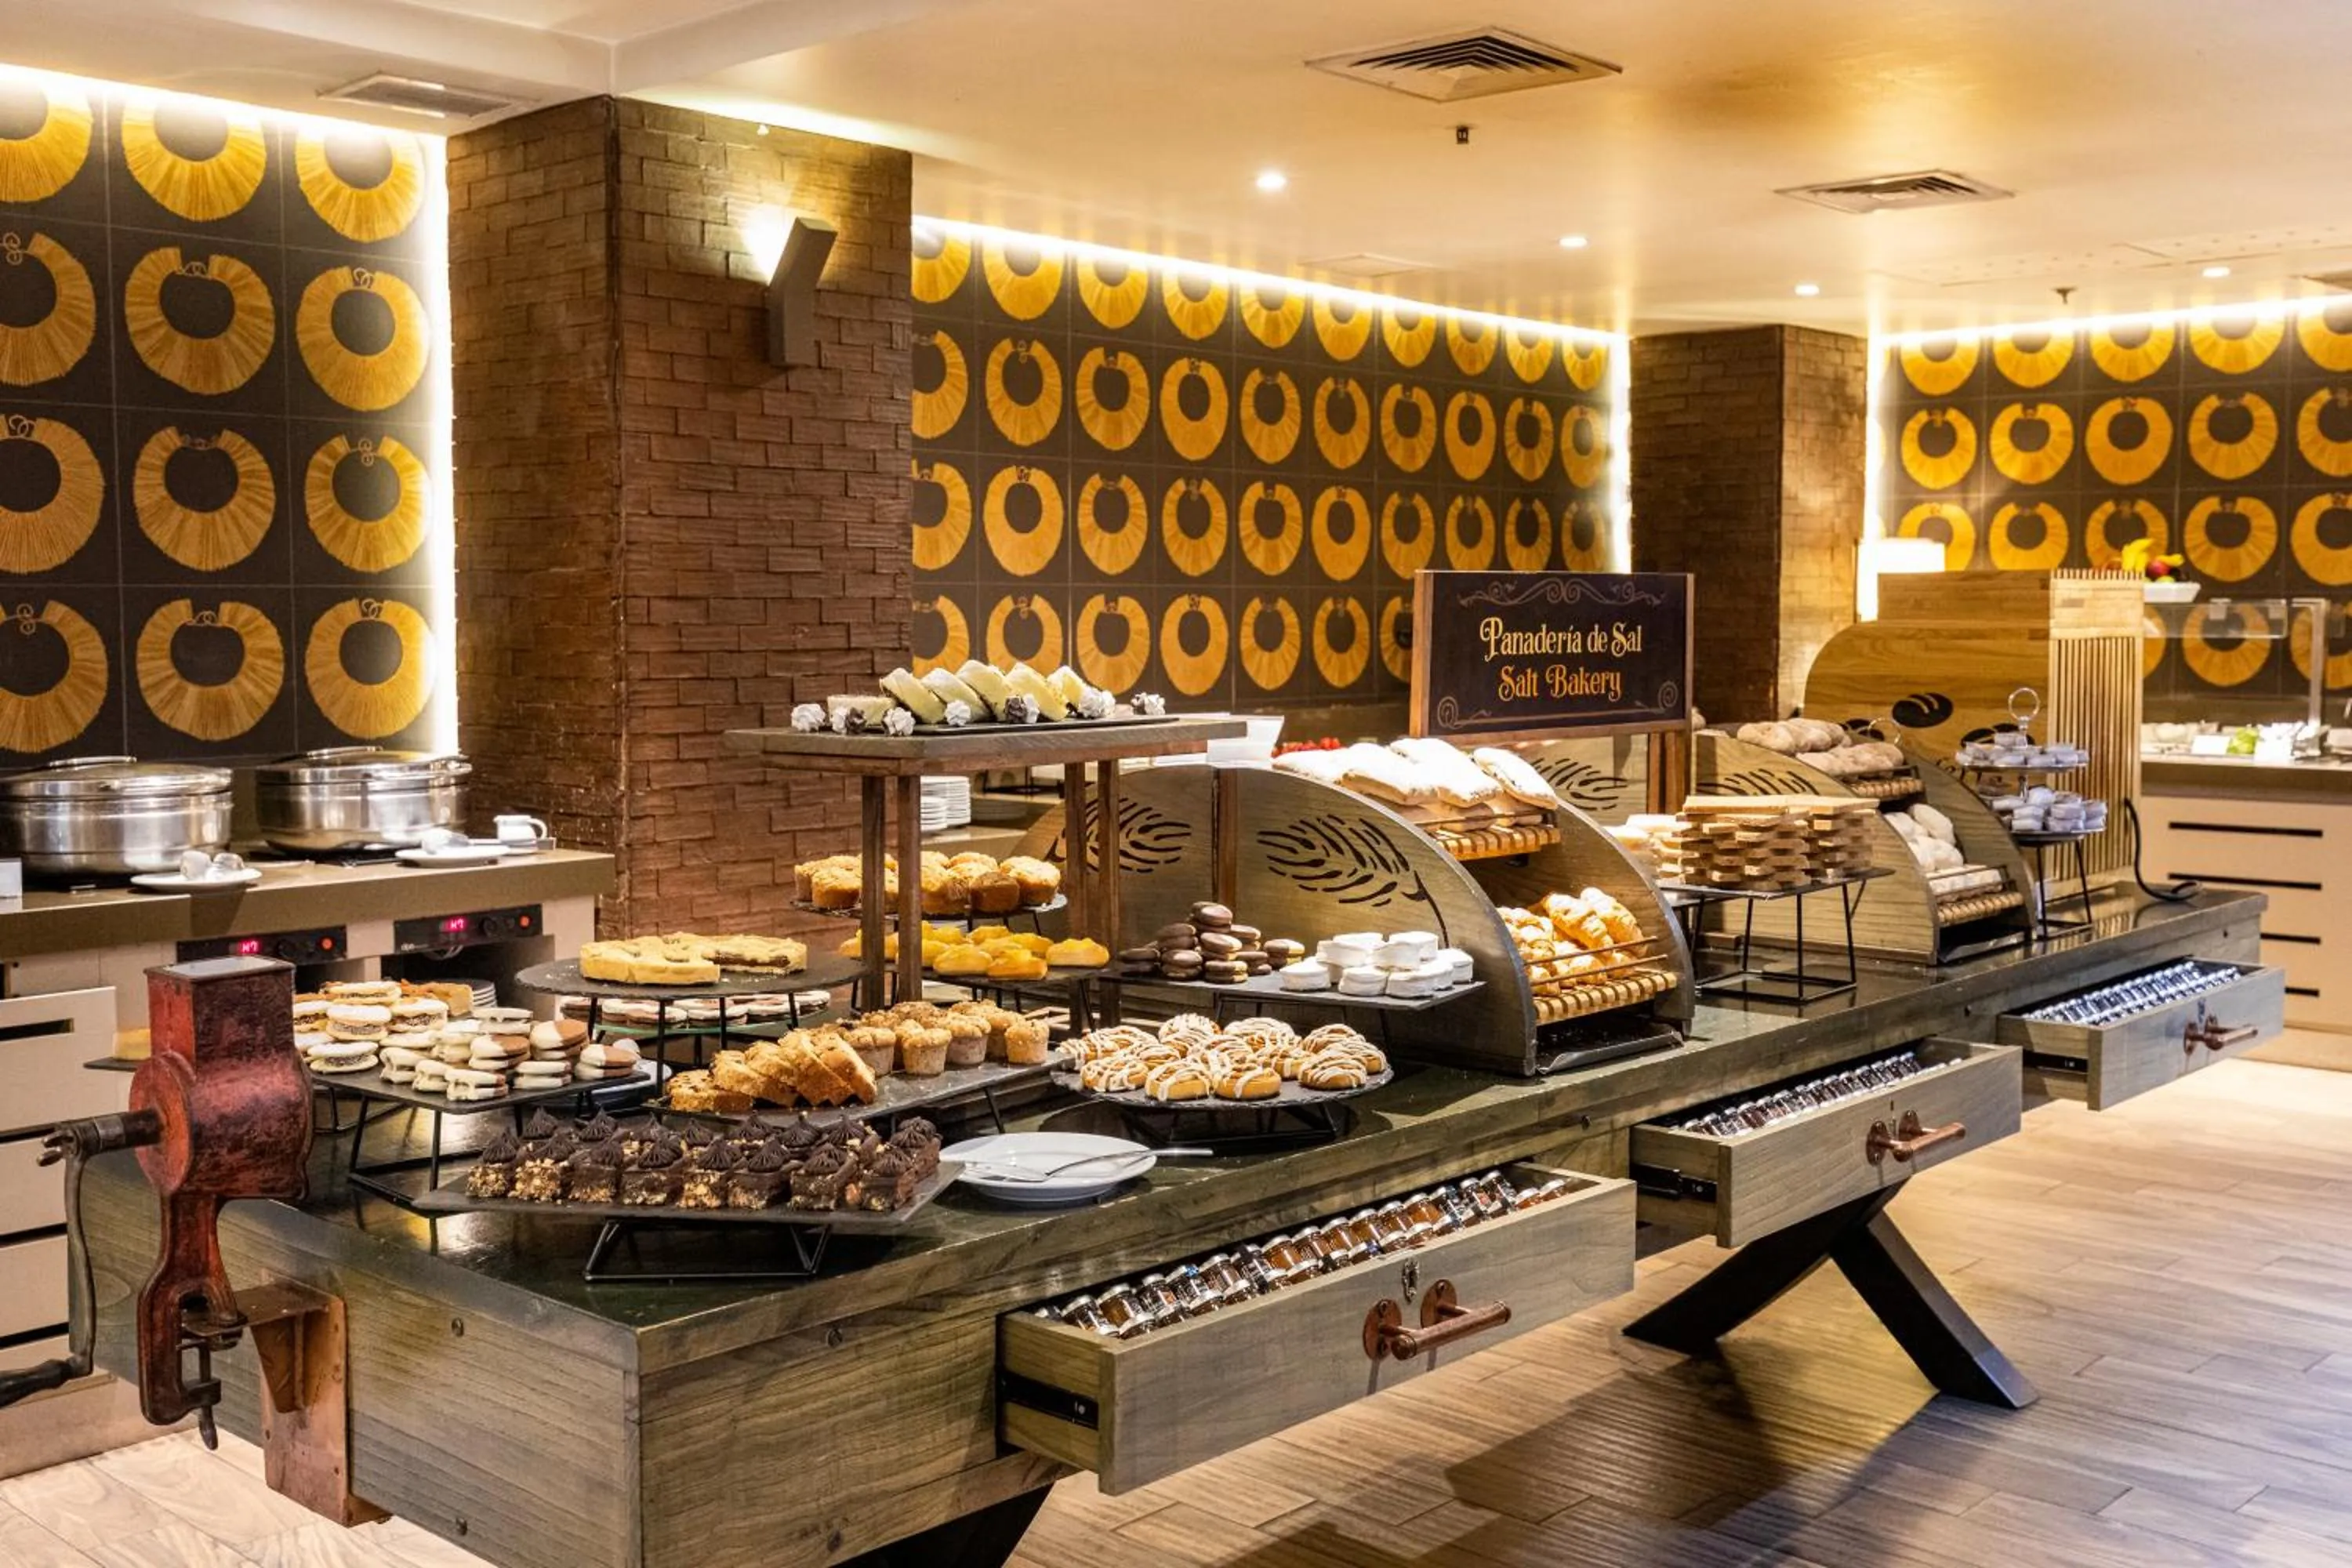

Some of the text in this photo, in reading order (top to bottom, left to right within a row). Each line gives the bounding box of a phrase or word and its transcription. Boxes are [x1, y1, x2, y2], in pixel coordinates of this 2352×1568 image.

[1479, 617, 1642, 662] Panadería de Sal
[1498, 664, 1622, 702] Salt Bakery
